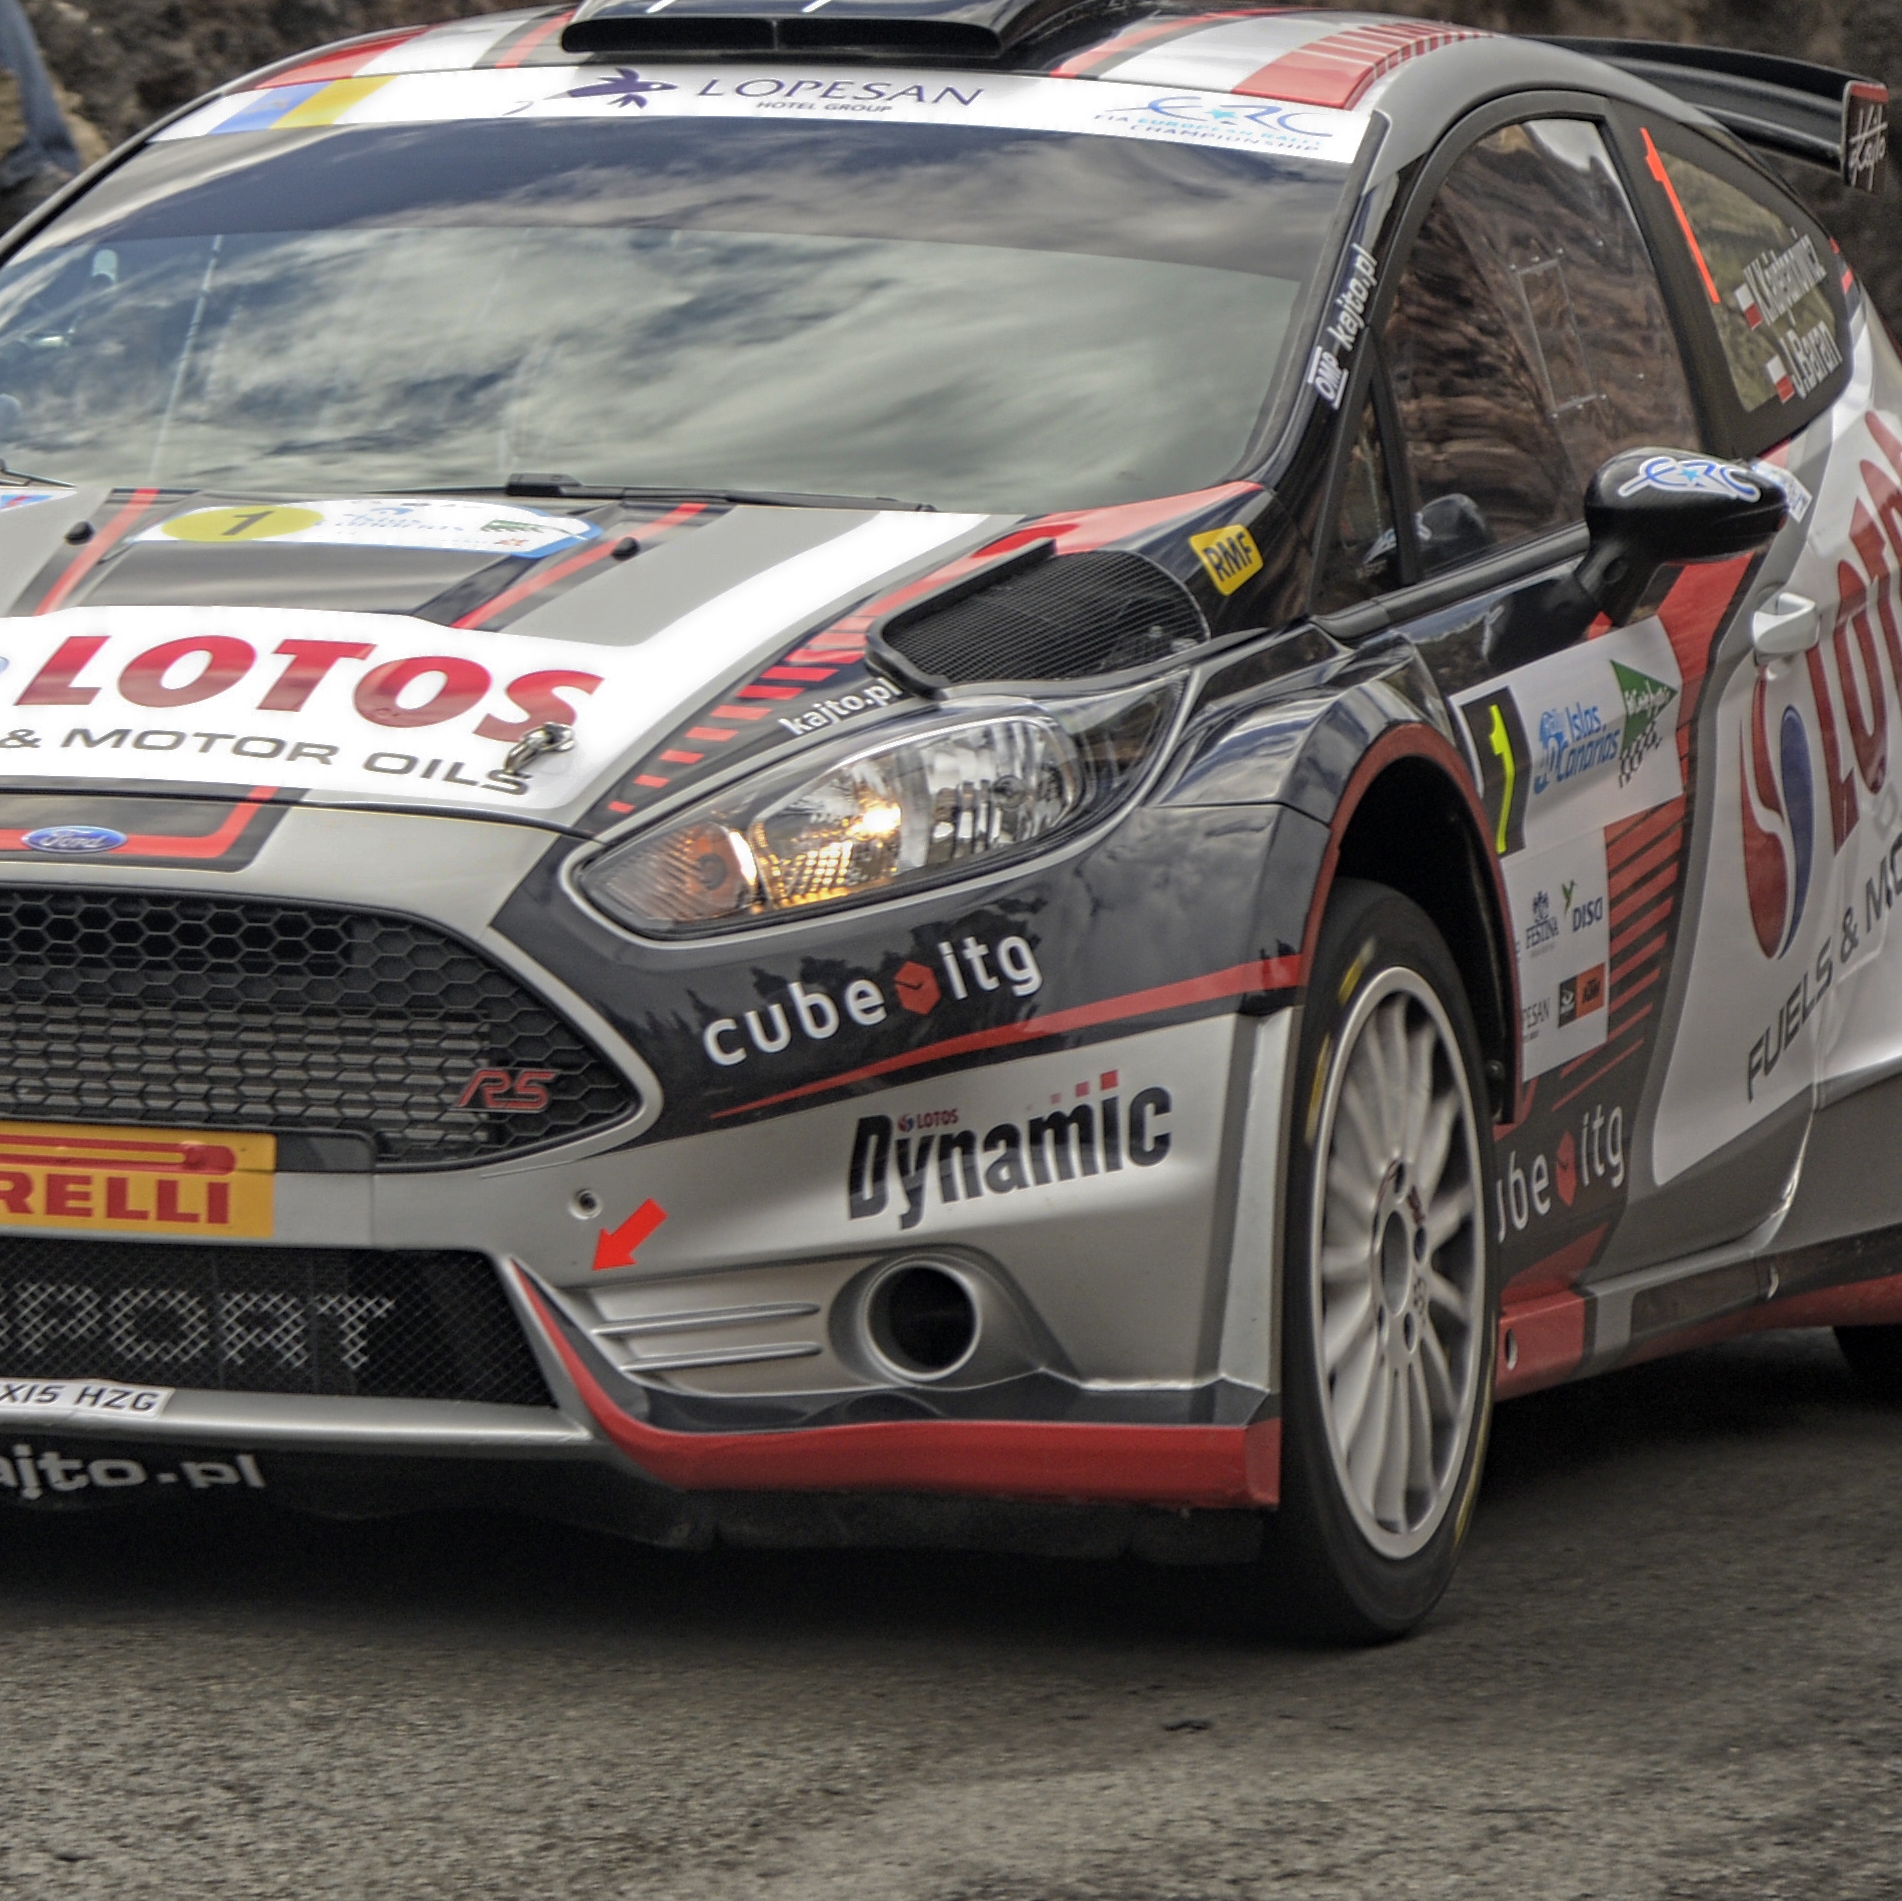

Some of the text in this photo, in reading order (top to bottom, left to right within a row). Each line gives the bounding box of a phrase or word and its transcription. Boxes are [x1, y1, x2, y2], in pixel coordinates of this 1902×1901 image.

[698, 78, 984, 106] LOPESAN
[757, 101, 892, 113] HOTEL GROUP
[1326, 243, 1378, 351] kajto.pl
[1310, 348, 1344, 405] OMP
[1778, 320, 1843, 399] J.Baran
[222, 510, 275, 536] 1
[1203, 532, 1253, 583] RMF
[13, 634, 604, 743] LOTOS
[778, 677, 903, 735] kajto.pl
[61, 728, 354, 767] MOTOR
[363, 752, 533, 795] OILS
[1489, 703, 1516, 854] 1
[40, 829, 109, 848] Ford
[703, 935, 1043, 1066] cube itg
[1747, 937, 1833, 1101] FUELS
[1840, 906, 1858, 963] &
[453, 1068, 559, 1111] RS
[916, 1109, 959, 1129] LOTOS
[1581, 1104, 1625, 1188] itg
[847, 1072, 1172, 1229] Dynamic
[73, 1385, 162, 1411] HZG
